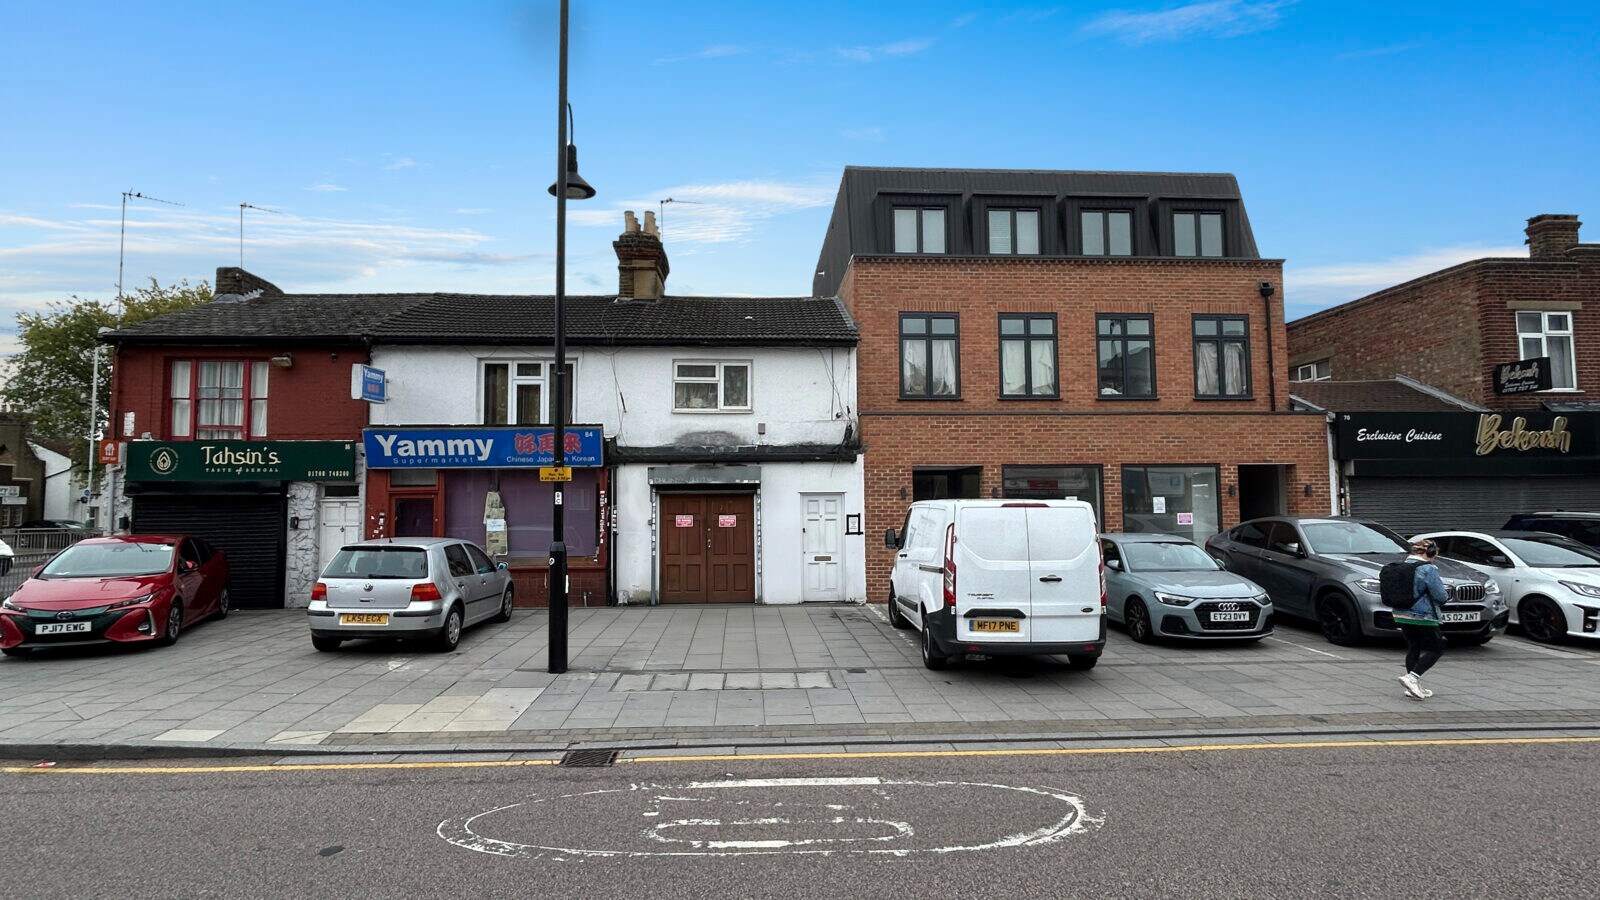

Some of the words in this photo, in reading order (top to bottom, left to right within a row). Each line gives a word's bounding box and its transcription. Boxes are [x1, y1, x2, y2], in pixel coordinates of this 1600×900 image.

[363, 367, 384, 384] Yammy
[1357, 428, 1402, 442] Exclusive
[1405, 428, 1442, 442] Cuisine
[374, 434, 494, 461] Yammy
[201, 446, 282, 464] Tahsin's
[392, 457, 475, 465] Supermarket
[235, 466, 244, 476] of
[1213, 612, 1232, 621] ET23
[1233, 612, 1247, 620] DVY
[1453, 613, 1463, 621] 02
[1464, 612, 1479, 620] ANT
[41, 624, 64, 633] PJ17
[66, 623, 85, 632] EWG
[998, 621, 1017, 631] PNE
